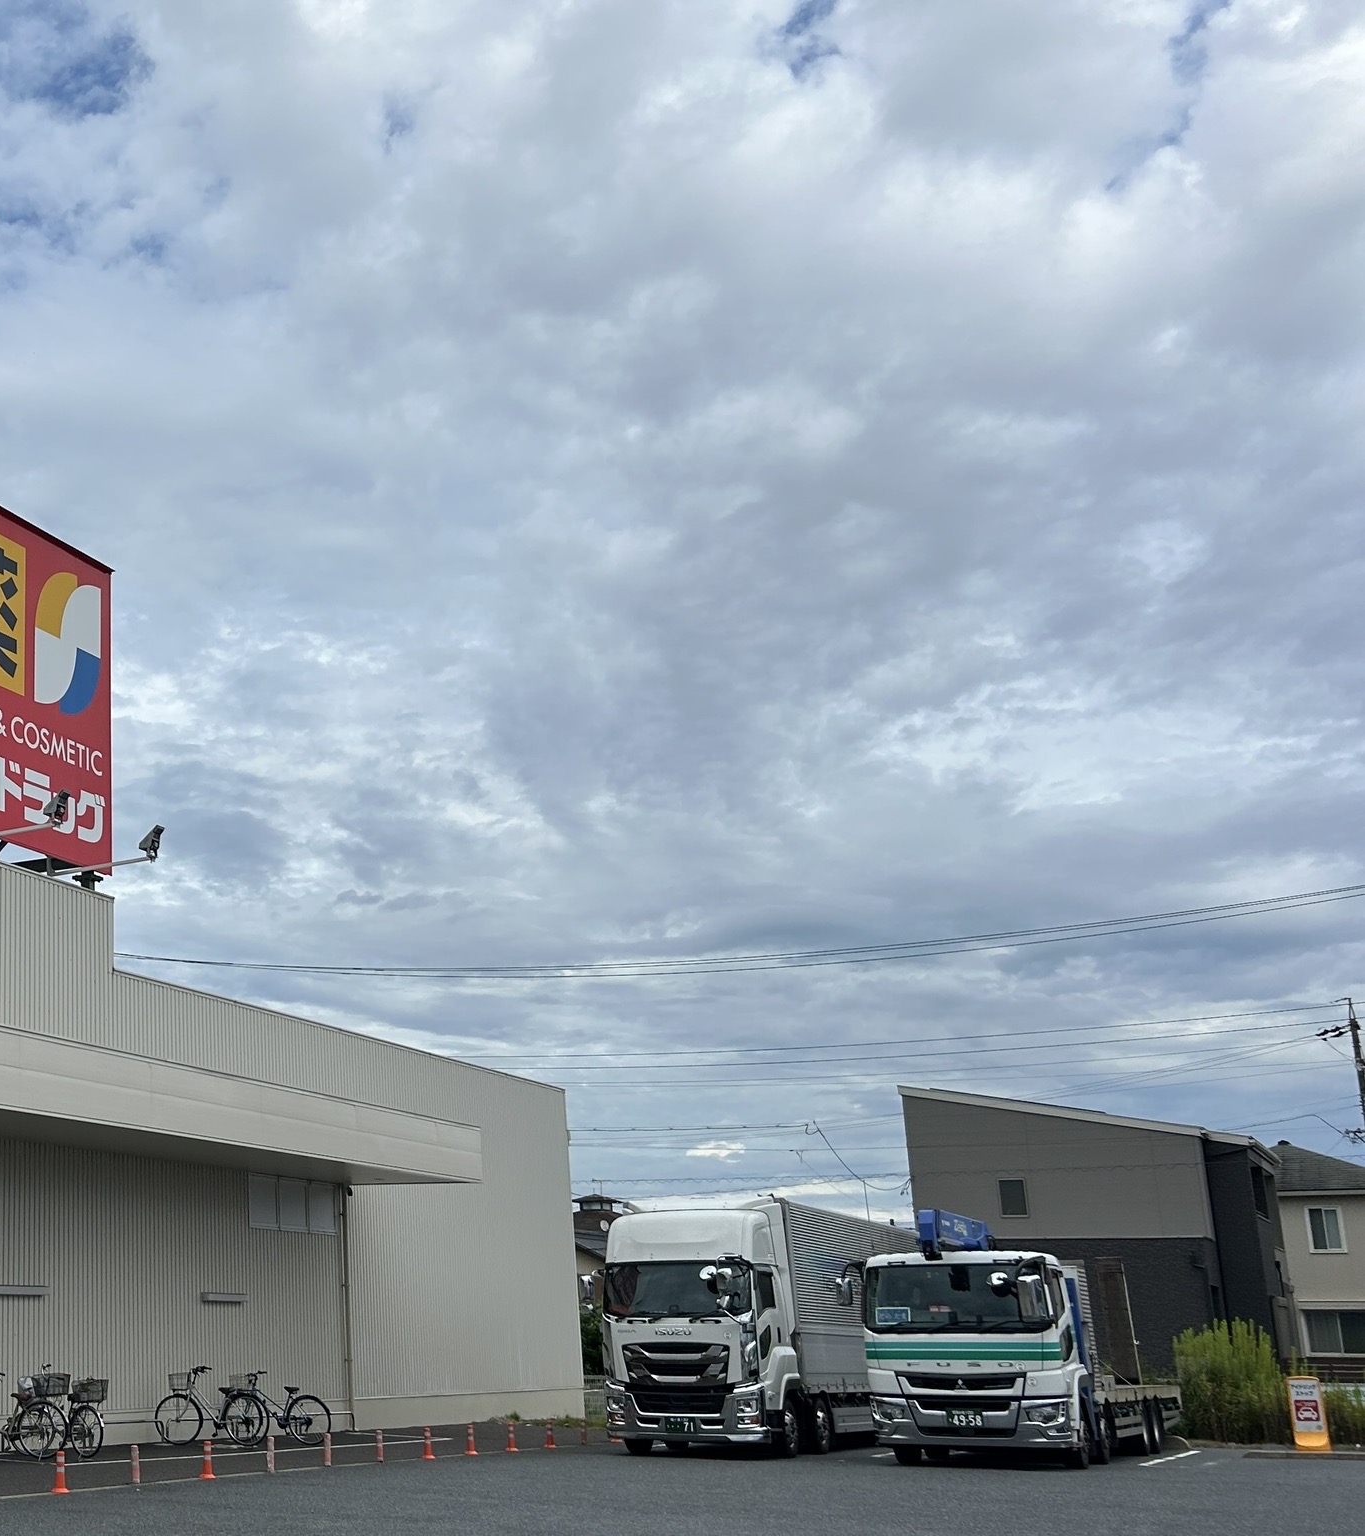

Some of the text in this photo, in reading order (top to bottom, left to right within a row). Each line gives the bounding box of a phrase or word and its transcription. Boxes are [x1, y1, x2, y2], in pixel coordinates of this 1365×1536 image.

[10, 716, 103, 777] COSMETIC
[655, 1327, 692, 1336] ISUZU
[953, 1414, 982, 1426] 49-58
[683, 1421, 694, 1432] 71
